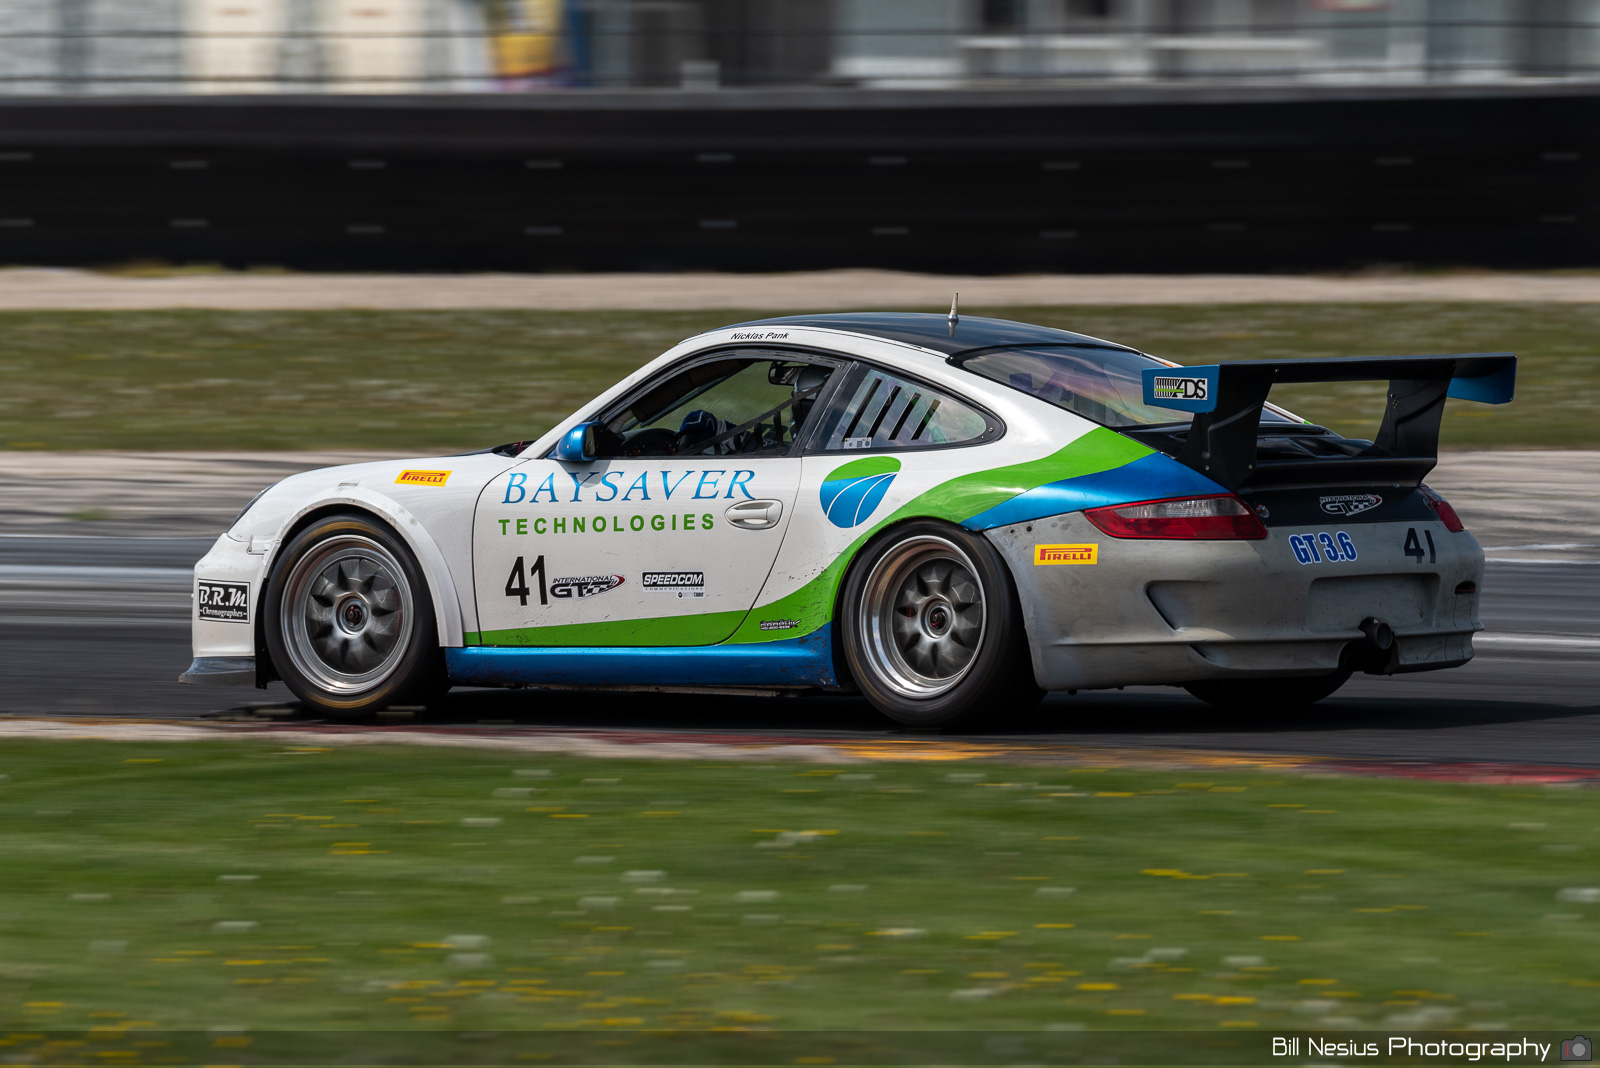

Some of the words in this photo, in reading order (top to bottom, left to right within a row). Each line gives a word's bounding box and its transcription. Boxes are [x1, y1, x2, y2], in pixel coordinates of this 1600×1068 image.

[730, 332, 763, 340] Nicklas
[765, 331, 790, 339] Pank
[1171, 378, 1206, 399] ADS
[400, 472, 446, 483] PIRELLI
[501, 469, 756, 504] BAYSAVER
[498, 513, 715, 536] TECHNOLOGIES
[1039, 547, 1093, 561] PIRELLI
[1288, 533, 1322, 565] GT
[1318, 531, 1357, 563] 3.6
[1403, 527, 1437, 564] 41
[504, 554, 548, 606] 41
[552, 575, 614, 584] INTERNATIONAL
[643, 574, 703, 585] SPEEDCOM
[549, 582, 600, 599] GT
